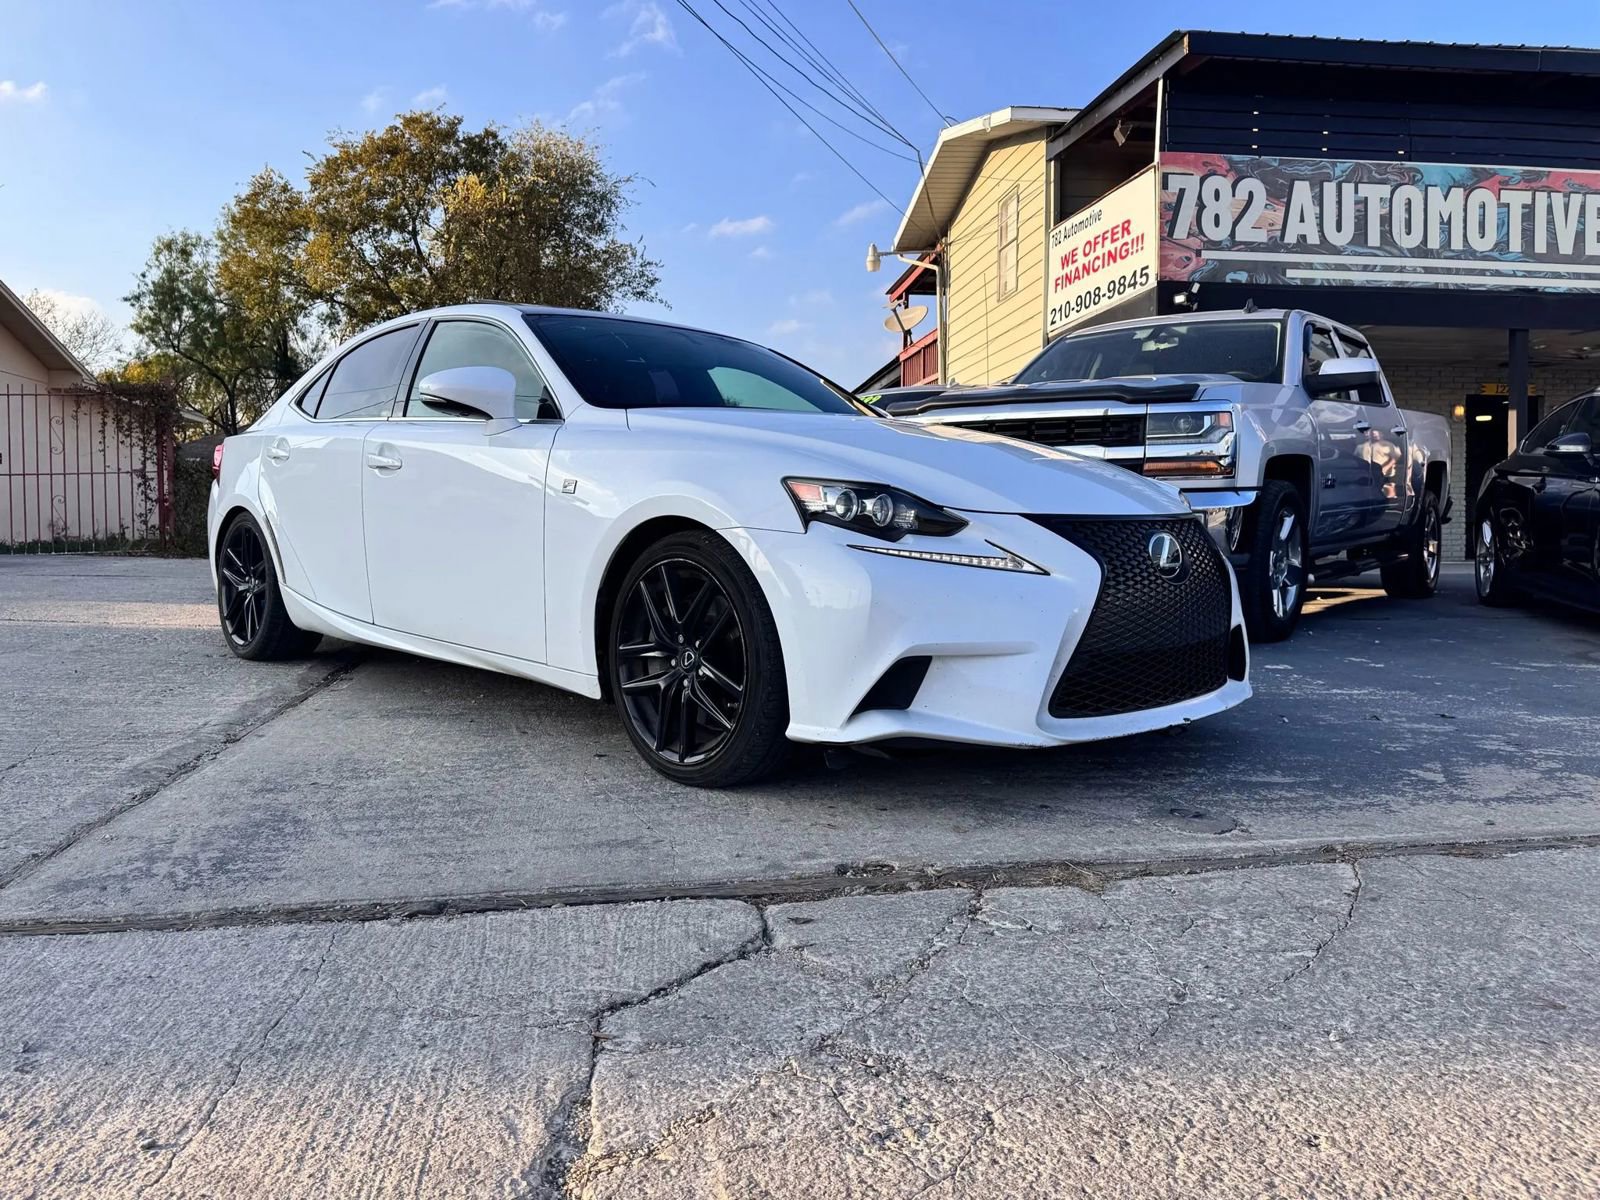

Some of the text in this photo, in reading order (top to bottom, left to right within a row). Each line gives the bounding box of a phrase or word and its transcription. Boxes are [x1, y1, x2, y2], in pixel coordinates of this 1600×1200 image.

[1051, 208, 1103, 249] 782 Automotive
[1060, 219, 1132, 270] WE OFFER
[1165, 173, 1600, 256] 782 AUTOMOTIVE
[1054, 233, 1145, 294] FINANCING!!!
[1050, 265, 1150, 326] 210-908-9845
